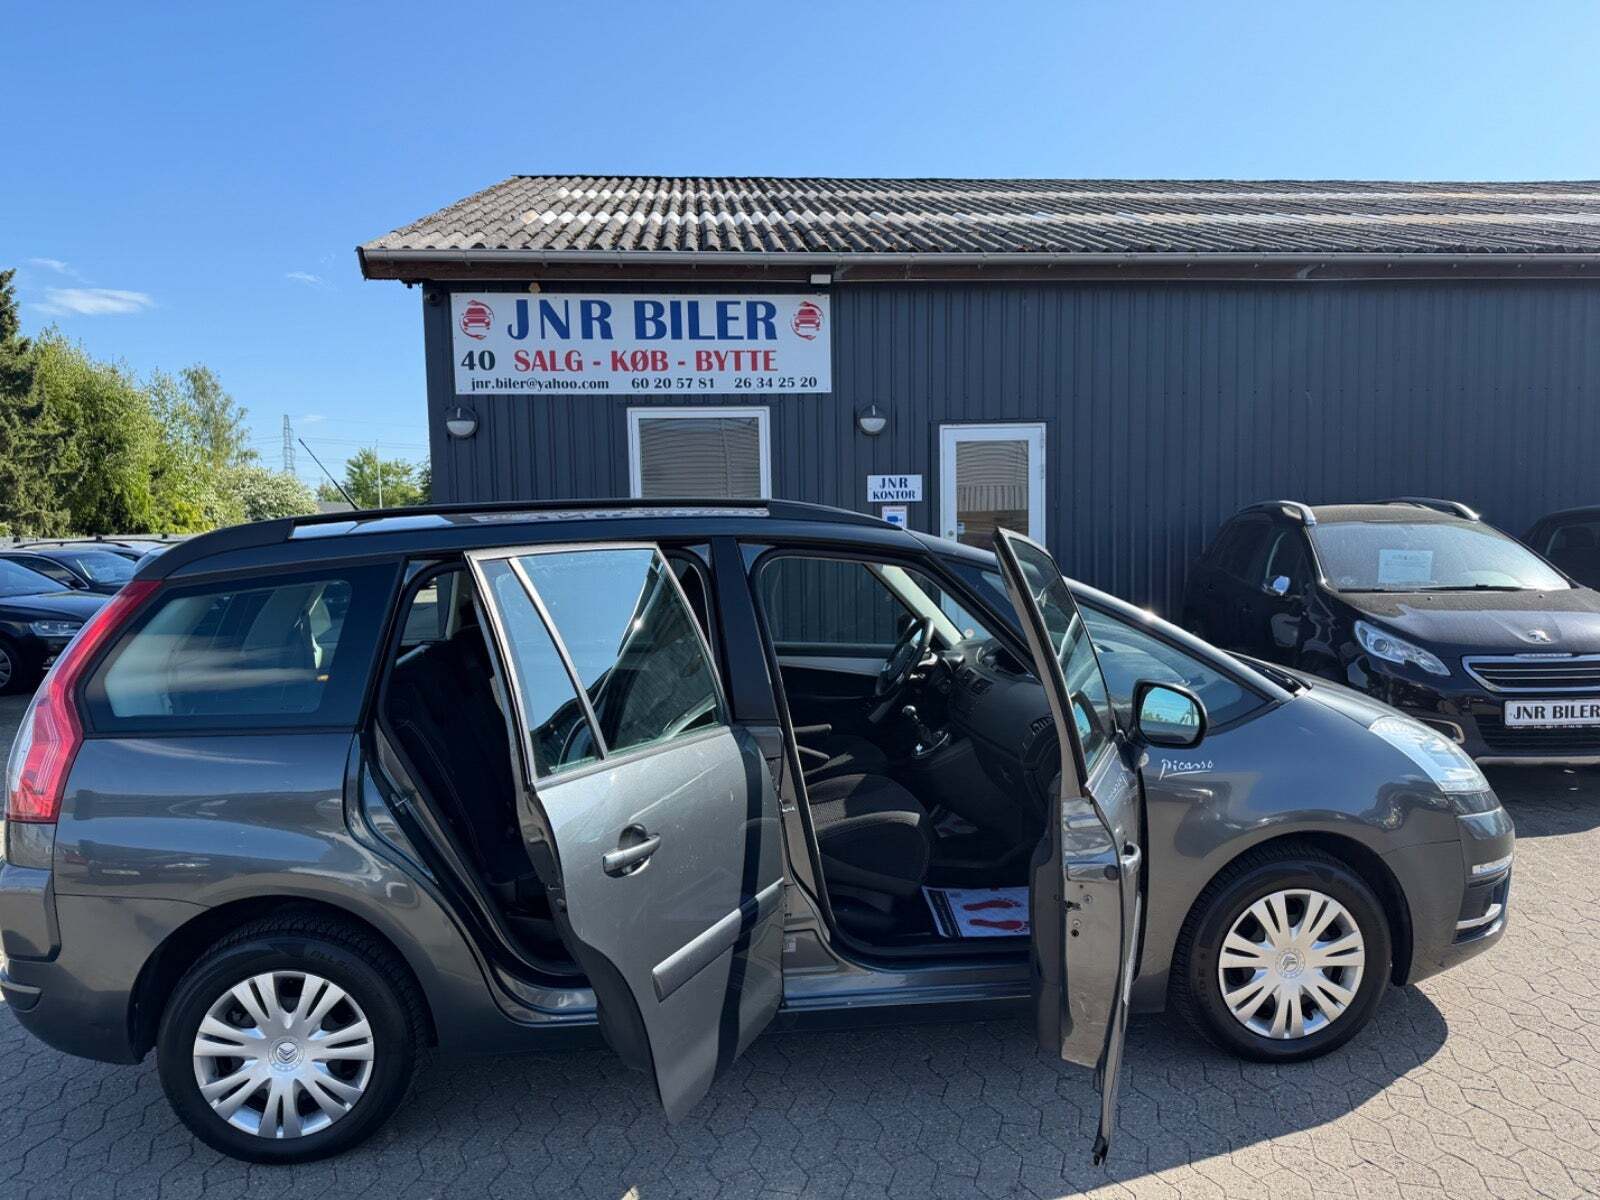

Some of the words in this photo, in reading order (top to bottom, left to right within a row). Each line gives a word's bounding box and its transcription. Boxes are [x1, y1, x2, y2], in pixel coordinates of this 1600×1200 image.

[507, 299, 613, 340] JNR
[634, 299, 778, 341] BILER
[460, 350, 496, 371] 40
[514, 349, 584, 372] SALG
[611, 349, 669, 373] KØB
[695, 349, 778, 372] BYTTE
[471, 377, 609, 392] jnr.biler@yahoo.com
[631, 377, 650, 389] 60
[654, 377, 671, 389] 20
[676, 377, 693, 389] 57
[698, 377, 715, 389] 81
[734, 377, 752, 389] 26
[756, 377, 773, 389] 34
[778, 377, 795, 389] 25
[800, 376, 818, 388] 20
[879, 477, 908, 488] JNR
[872, 490, 916, 500] KONTOR
[1513, 705, 1546, 720] JNR
[1552, 703, 1600, 720] BILER
